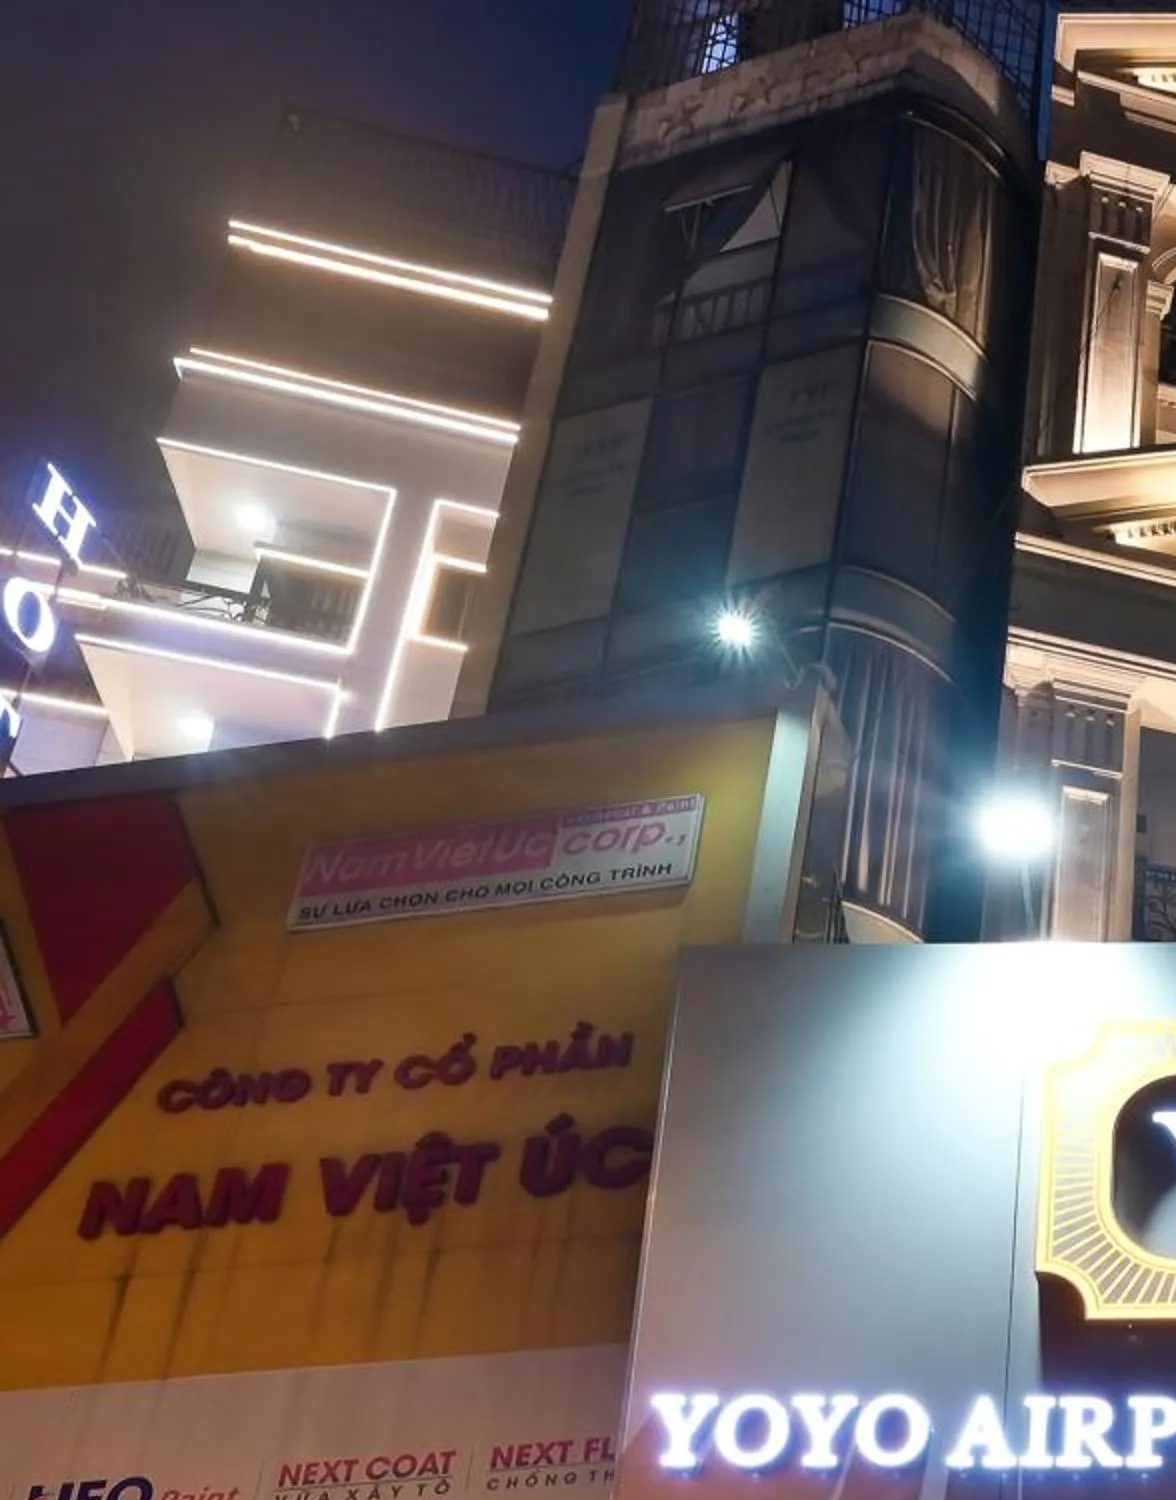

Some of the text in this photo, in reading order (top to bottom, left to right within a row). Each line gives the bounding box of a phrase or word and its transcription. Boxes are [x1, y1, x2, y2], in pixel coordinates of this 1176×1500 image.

[157, 1021, 636, 1114] CÔNG TY CỔ PHẦN
[77, 1112, 654, 1240] NAM VIỆT ÚC
[651, 1393, 932, 1469] YOYO
[277, 1450, 457, 1488] NEXT COAT
[490, 1437, 616, 1469] NEXT FL
[416, 1478, 451, 1496] TÔ
[588, 1469, 616, 1483] TH
